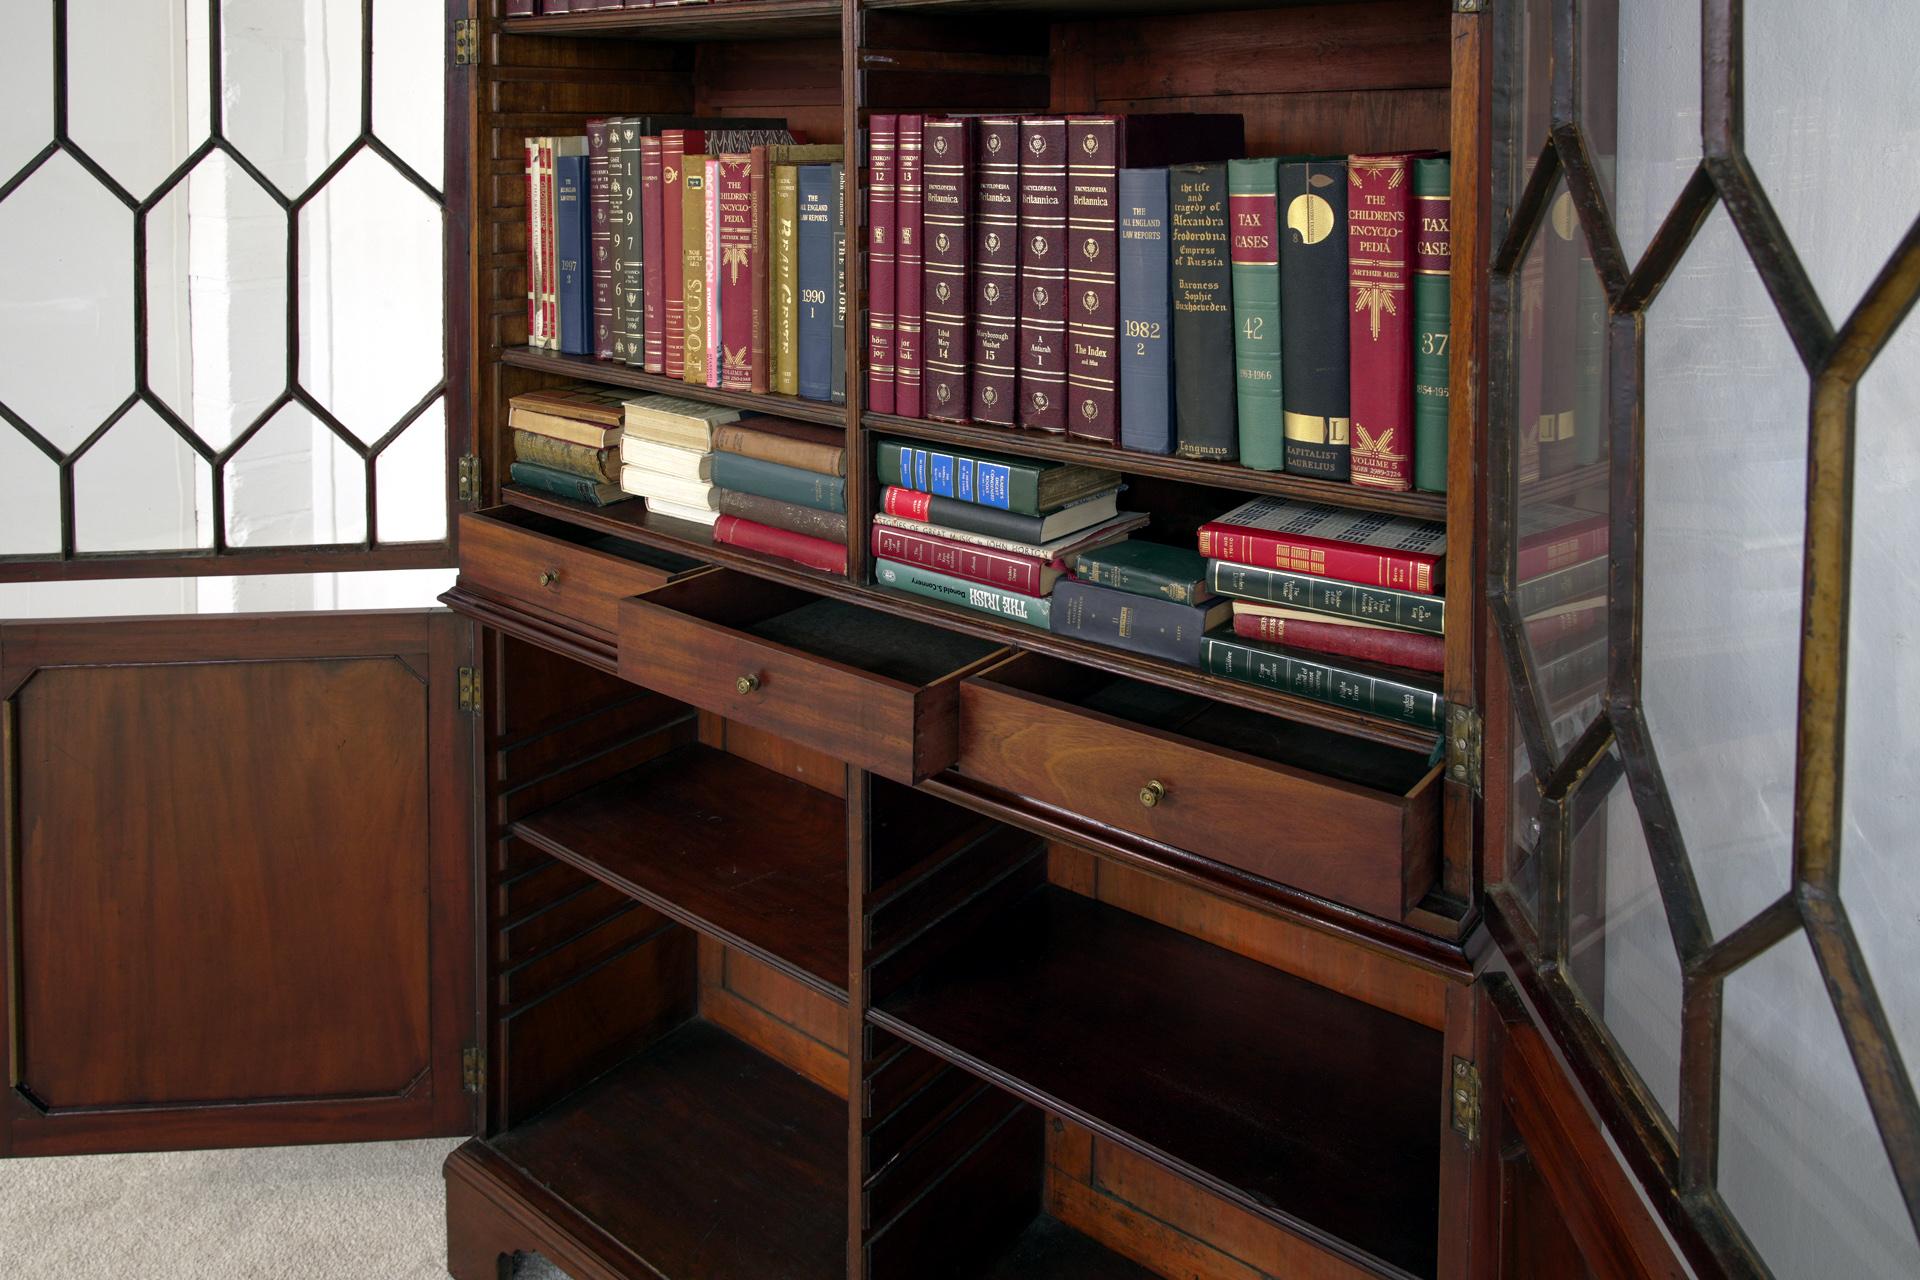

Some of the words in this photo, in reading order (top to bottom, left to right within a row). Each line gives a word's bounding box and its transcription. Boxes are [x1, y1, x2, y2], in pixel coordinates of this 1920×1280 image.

[706, 166, 714, 197] RACE
[875, 172, 885, 181] 12
[903, 172, 912, 181] 13
[727, 181, 742, 189] THE
[1180, 183, 1192, 193] the
[1194, 182, 1211, 192] life
[927, 193, 959, 204] Britannica
[1022, 194, 1059, 205] Britannica
[1073, 195, 1108, 206] Britannica
[1187, 193, 1203, 202] and
[1364, 195, 1386, 205] THE
[807, 204, 828, 212] ENGLAND
[1132, 207, 1146, 216] THE
[1174, 203, 1206, 215] tragedy
[1209, 202, 1221, 212] of
[724, 214, 745, 223] PEDIA
[808, 214, 828, 222] REPORTS
[1173, 213, 1224, 226] Alexandra
[1238, 213, 1262, 227] TAX
[1348, 209, 1406, 222] CHILDREN'S
[1122, 218, 1131, 226] ALL
[1132, 219, 1161, 227] ENGLAND
[1422, 218, 1449, 232] TAX
[1122, 230, 1133, 239] LAW
[1134, 231, 1161, 240] REPORTS
[1172, 228, 1226, 241] Feodorovna
[1350, 225, 1403, 238] ENCYCLO-
[706, 201, 714, 283] NAVIGATION
[779, 218, 792, 278] BEAU
[1235, 235, 1269, 249] CASES
[1359, 241, 1391, 254] PEDIA
[838, 239, 846, 265] THE
[1179, 244, 1216, 257] Empress
[1418, 242, 1451, 256] CASE
[561, 260, 577, 271] 1997
[1175, 257, 1183, 267] of
[1186, 256, 1224, 267] Russia
[1352, 269, 1381, 278] ARTHUR
[1382, 270, 1400, 279] MEE
[1178, 278, 1219, 290] Baroness
[802, 289, 826, 304] 1990
[838, 271, 847, 321] MAJORS
[1184, 290, 1212, 301] Sophie
[810, 307, 815, 318] 1
[686, 279, 702, 371] FOCUS
[1125, 319, 1161, 339] 1982
[1242, 317, 1264, 340] 42
[900, 337, 910, 347] jor
[976, 329, 1009, 342] Maryborough
[1037, 335, 1043, 343] A
[937, 338, 950, 348] Mary
[982, 340, 1001, 349] Mushet
[1030, 343, 1051, 353] Antarah
[1136, 343, 1145, 356] 2
[1421, 332, 1449, 356] 37
[873, 348, 886, 359] jop
[939, 348, 948, 359] 14
[985, 350, 995, 360] 15
[1074, 343, 1087, 354] The
[1088, 345, 1108, 358] Index
[1037, 355, 1043, 365] 1
[1330, 420, 1345, 441] L
[1179, 440, 1228, 455] Longmans
[1287, 457, 1336, 472] LAURELIUS
[1352, 456, 1389, 469] VOLUME
[1392, 462, 1398, 470] 5
[910, 524, 919, 532] OF
[923, 527, 946, 538] GREAT
[986, 541, 1008, 552] JOHN
[1012, 545, 1050, 560] HORTON
[911, 577, 938, 592] Connery
[943, 586, 966, 598] Donald
[969, 588, 1000, 612] IRISH
[1002, 595, 1027, 619] THE
